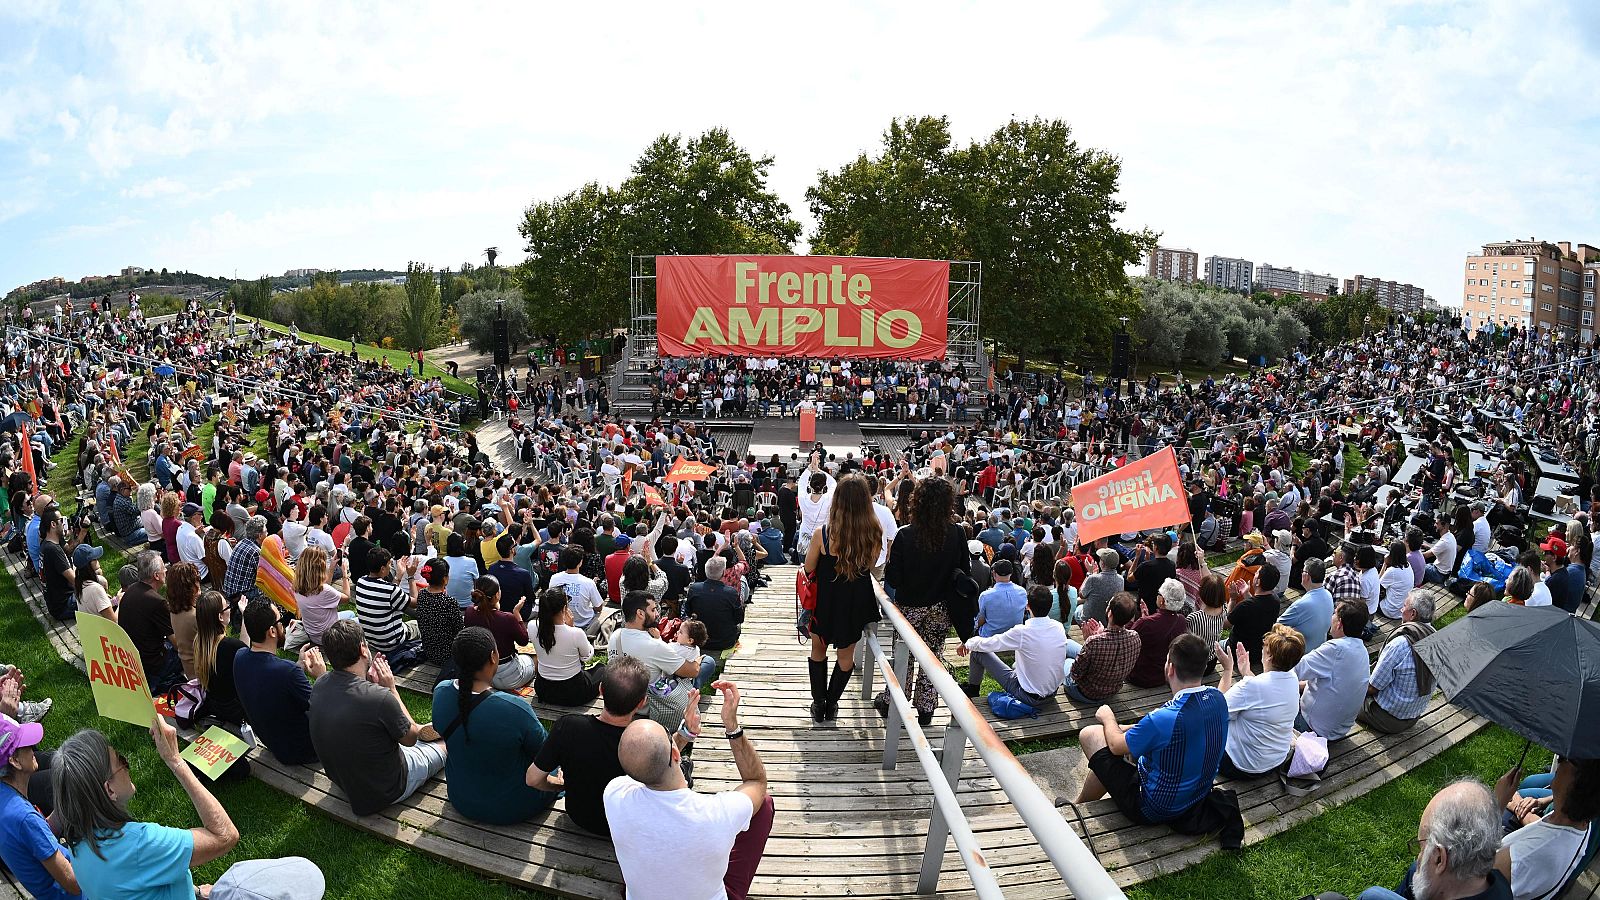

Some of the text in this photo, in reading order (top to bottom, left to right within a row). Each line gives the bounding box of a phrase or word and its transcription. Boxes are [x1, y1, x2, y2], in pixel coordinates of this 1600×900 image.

[735, 262, 872, 306] Frente
[683, 306, 922, 348] AMPLIO
[194, 736, 237, 764] AMPLIO
[194, 745, 220, 767] Frente
